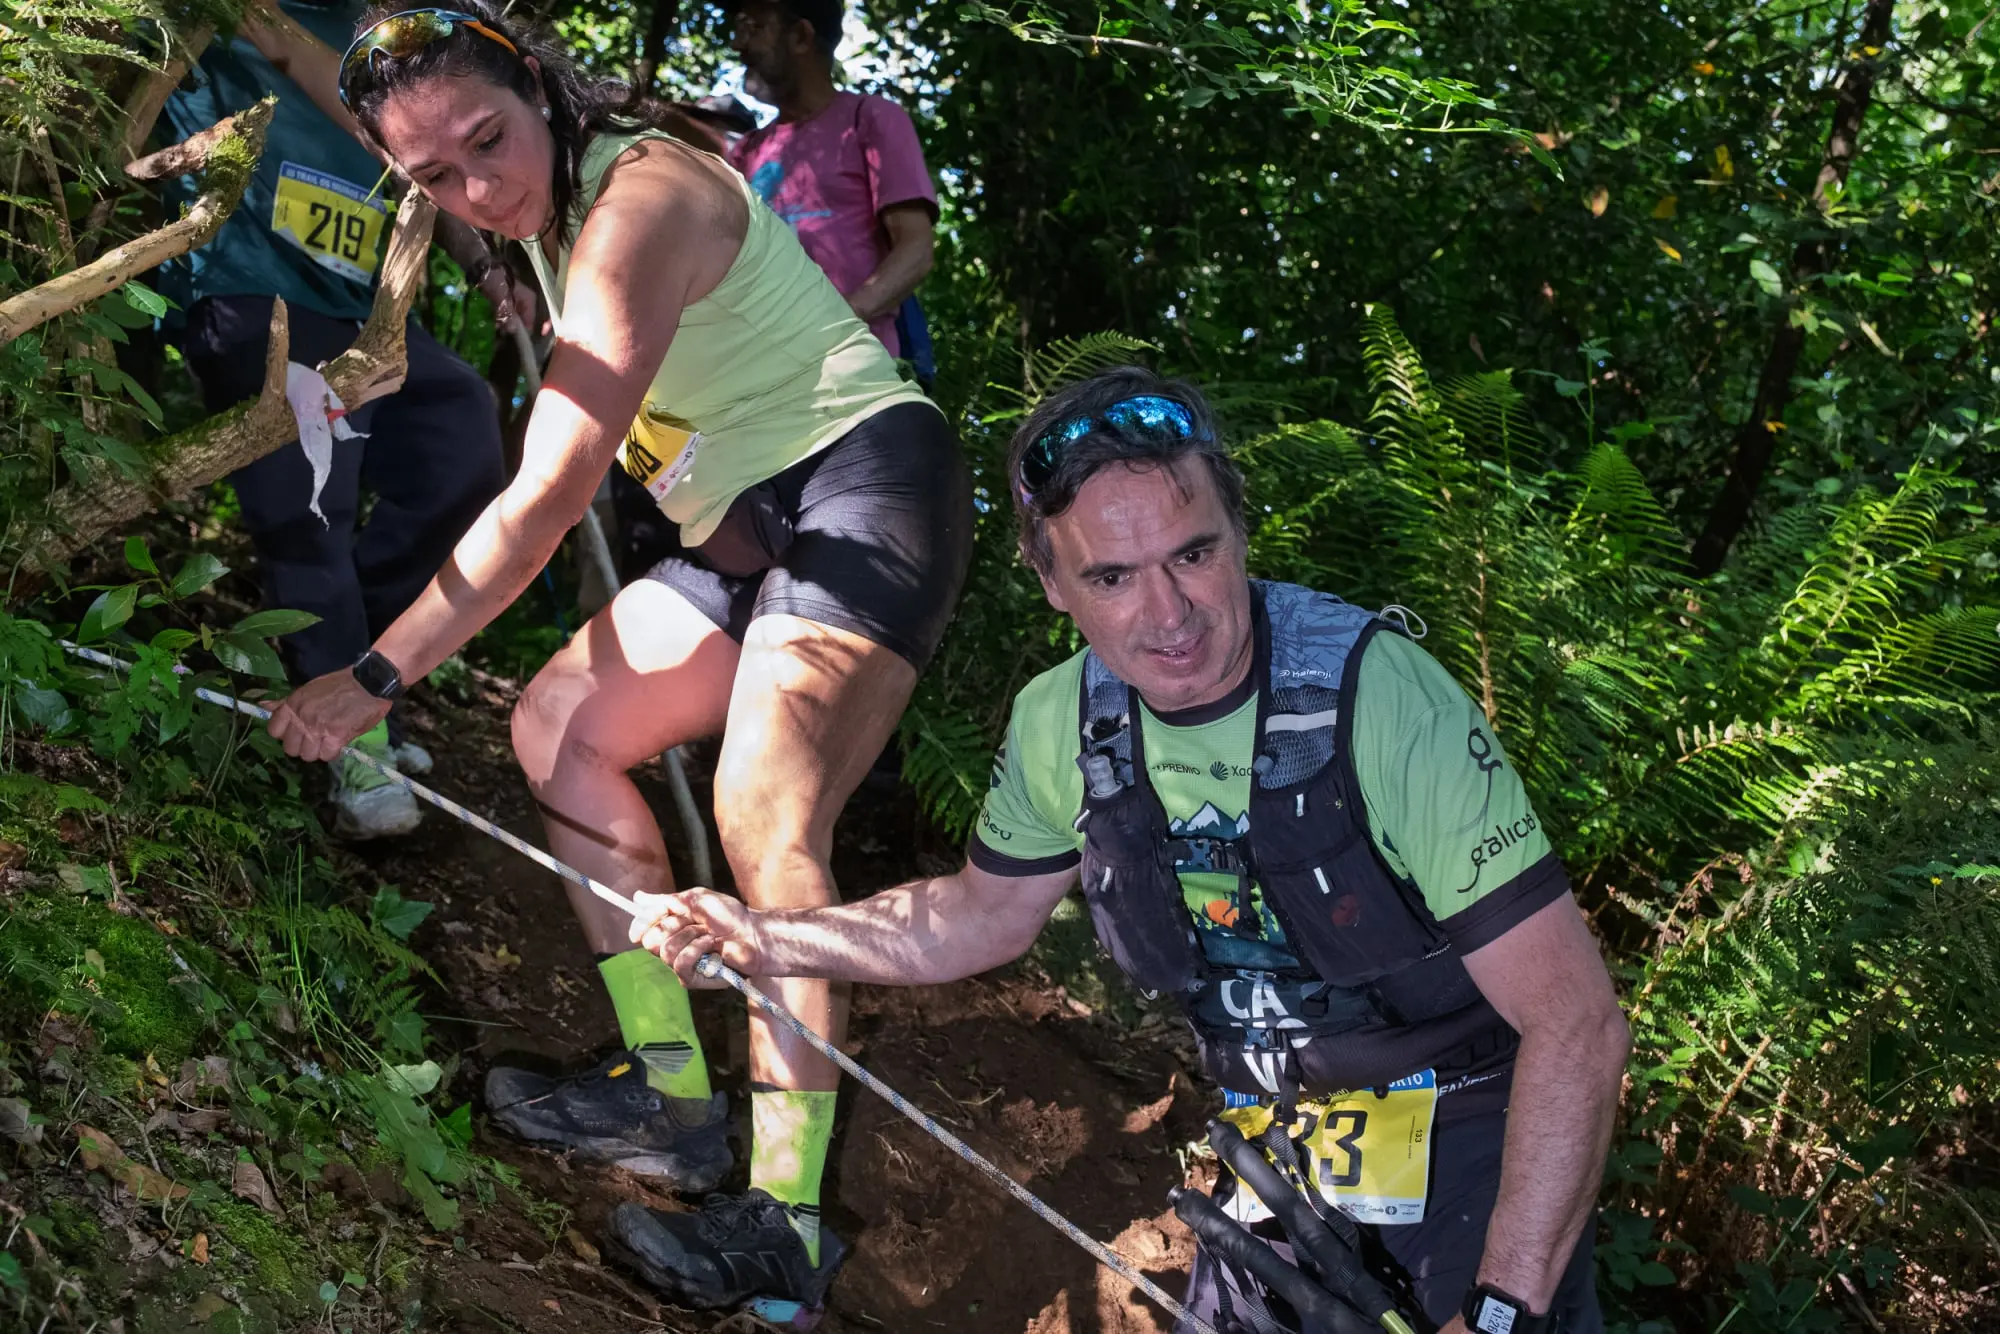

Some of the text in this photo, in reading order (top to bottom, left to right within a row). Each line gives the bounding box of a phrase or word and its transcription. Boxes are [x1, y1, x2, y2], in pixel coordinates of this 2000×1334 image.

[305, 202, 365, 262] 219
[1162, 763, 1201, 776] PREMIO
[1415, 1128, 1423, 1143] 133
